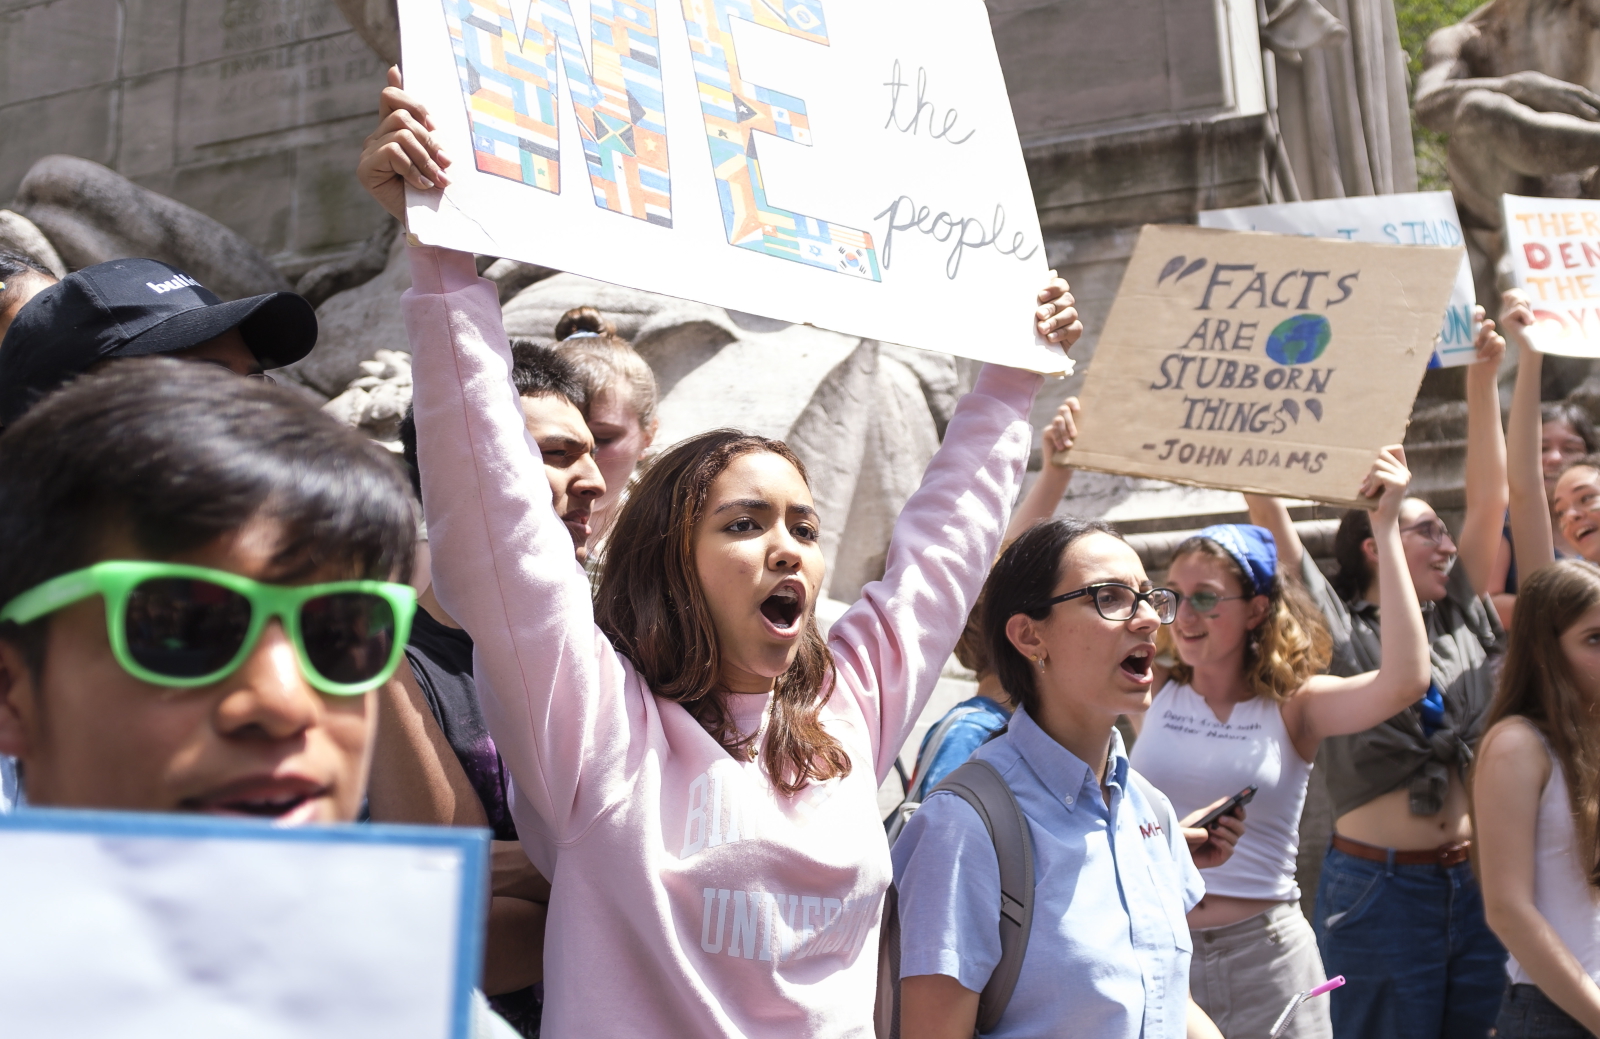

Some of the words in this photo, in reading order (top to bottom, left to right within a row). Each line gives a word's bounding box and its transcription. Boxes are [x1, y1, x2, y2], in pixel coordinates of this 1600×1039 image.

[882, 58, 977, 145] the
[442, 0, 882, 282] WE
[873, 194, 1039, 281] people
[1383, 218, 1462, 247] STAND
[1178, 317, 1260, 351] ARE
[1149, 353, 1337, 394] STUBBORN
[1238, 446, 1329, 475] ADAMS
